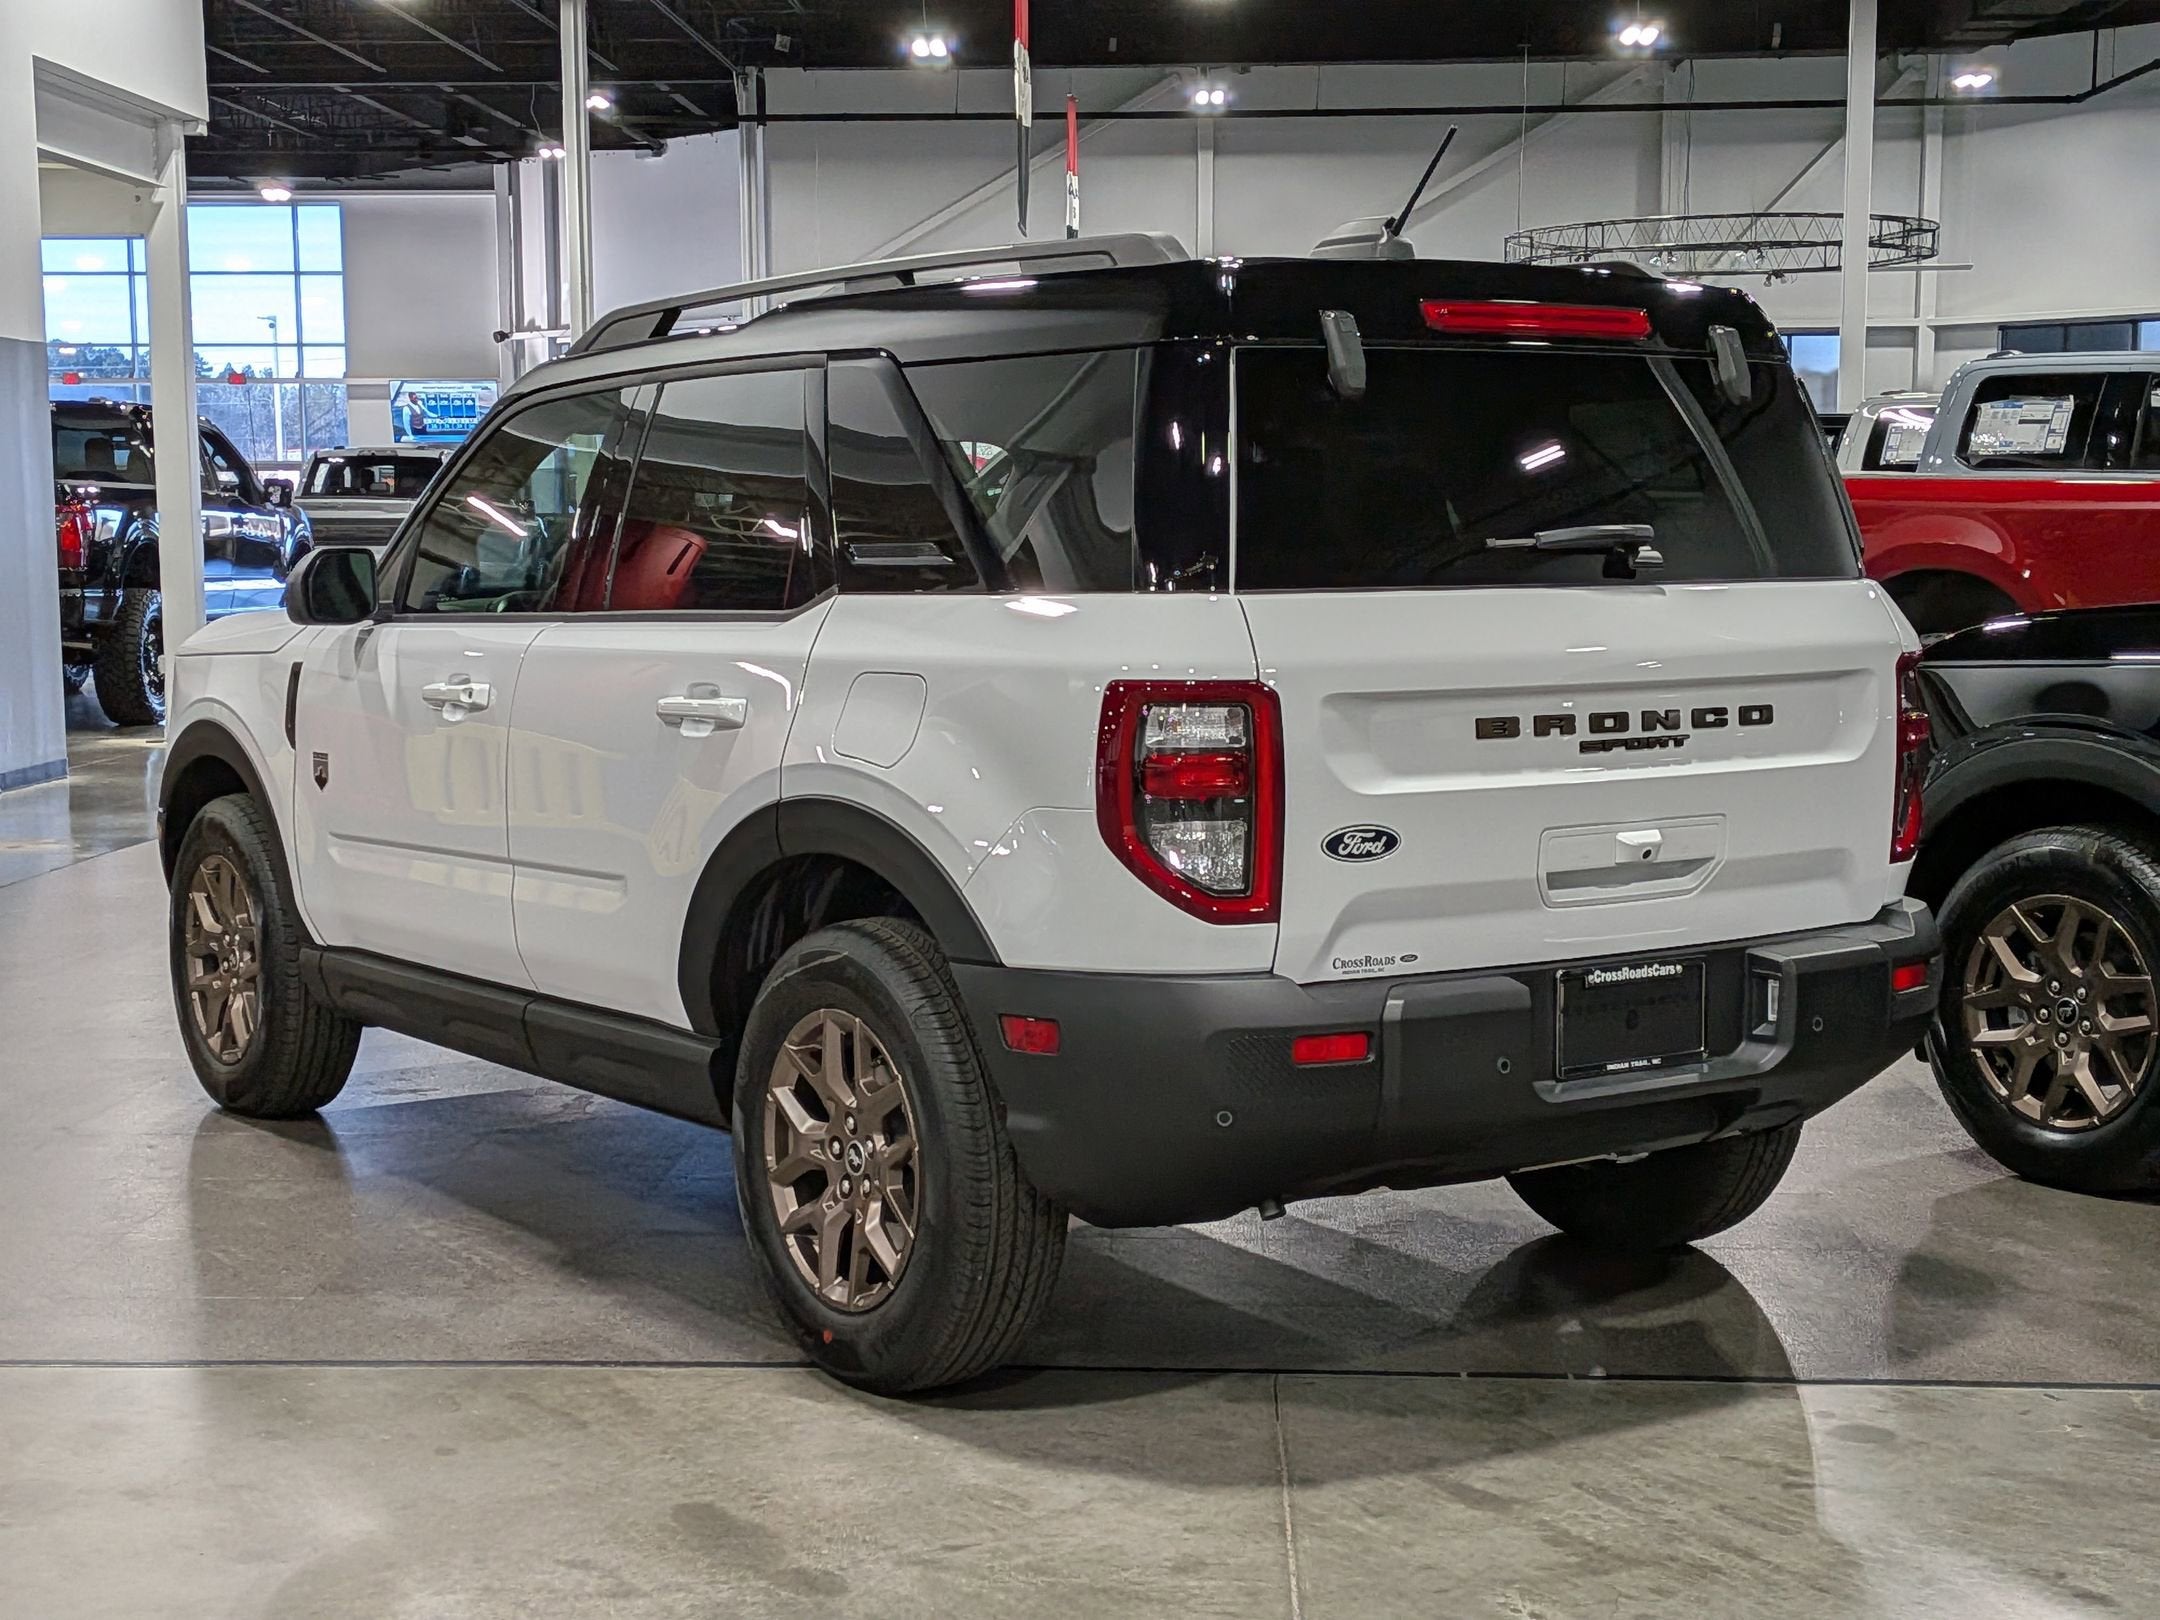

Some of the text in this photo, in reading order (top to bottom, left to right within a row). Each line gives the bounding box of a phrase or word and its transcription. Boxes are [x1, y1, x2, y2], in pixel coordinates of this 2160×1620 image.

[1476, 704, 1774, 739] BRONCO
[1579, 734, 1690, 753] SPORT
[1338, 831, 1387, 855] Ford
